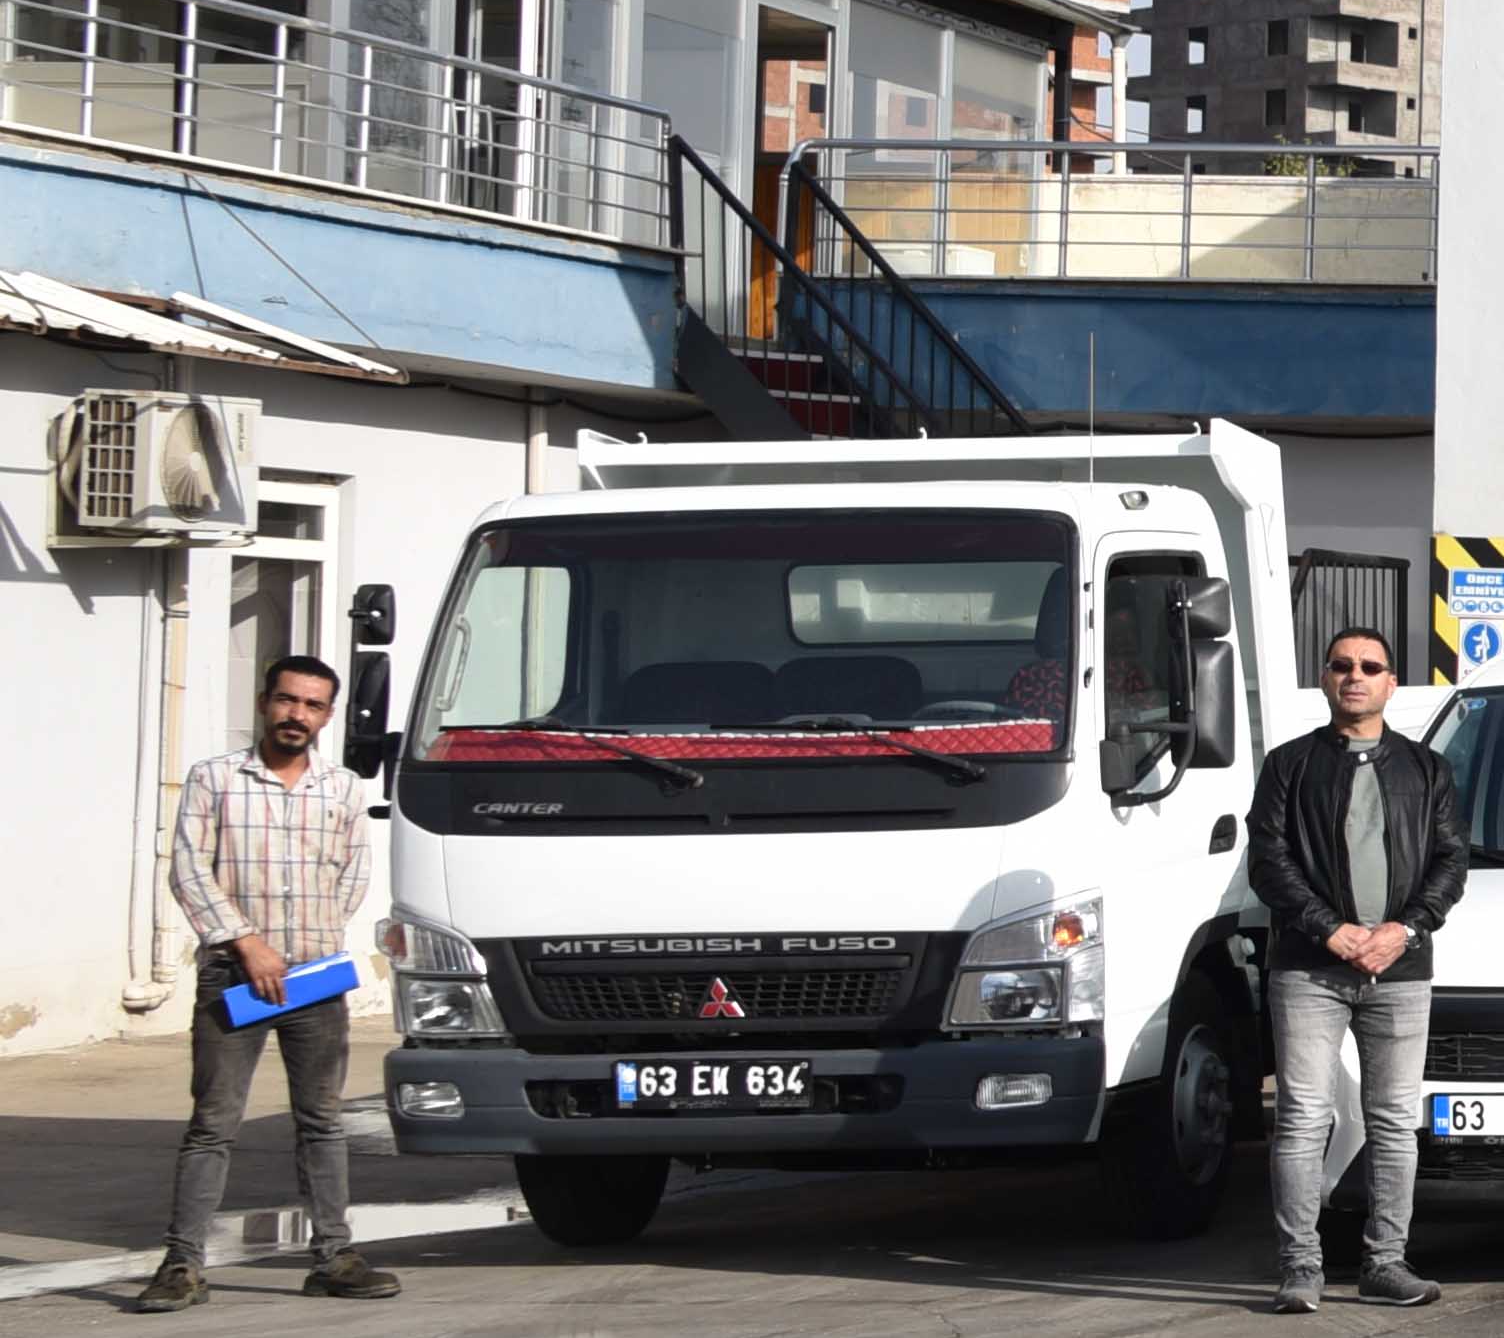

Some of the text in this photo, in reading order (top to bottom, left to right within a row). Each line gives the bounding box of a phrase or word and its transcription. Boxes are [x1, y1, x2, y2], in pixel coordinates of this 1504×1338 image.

[473, 803, 564, 815] CANTER
[542, 936, 896, 955] MITSUBISH FUSO
[640, 1066, 677, 1096] 63
[746, 1065, 805, 1096] 634
[1452, 1100, 1485, 1131] 63
